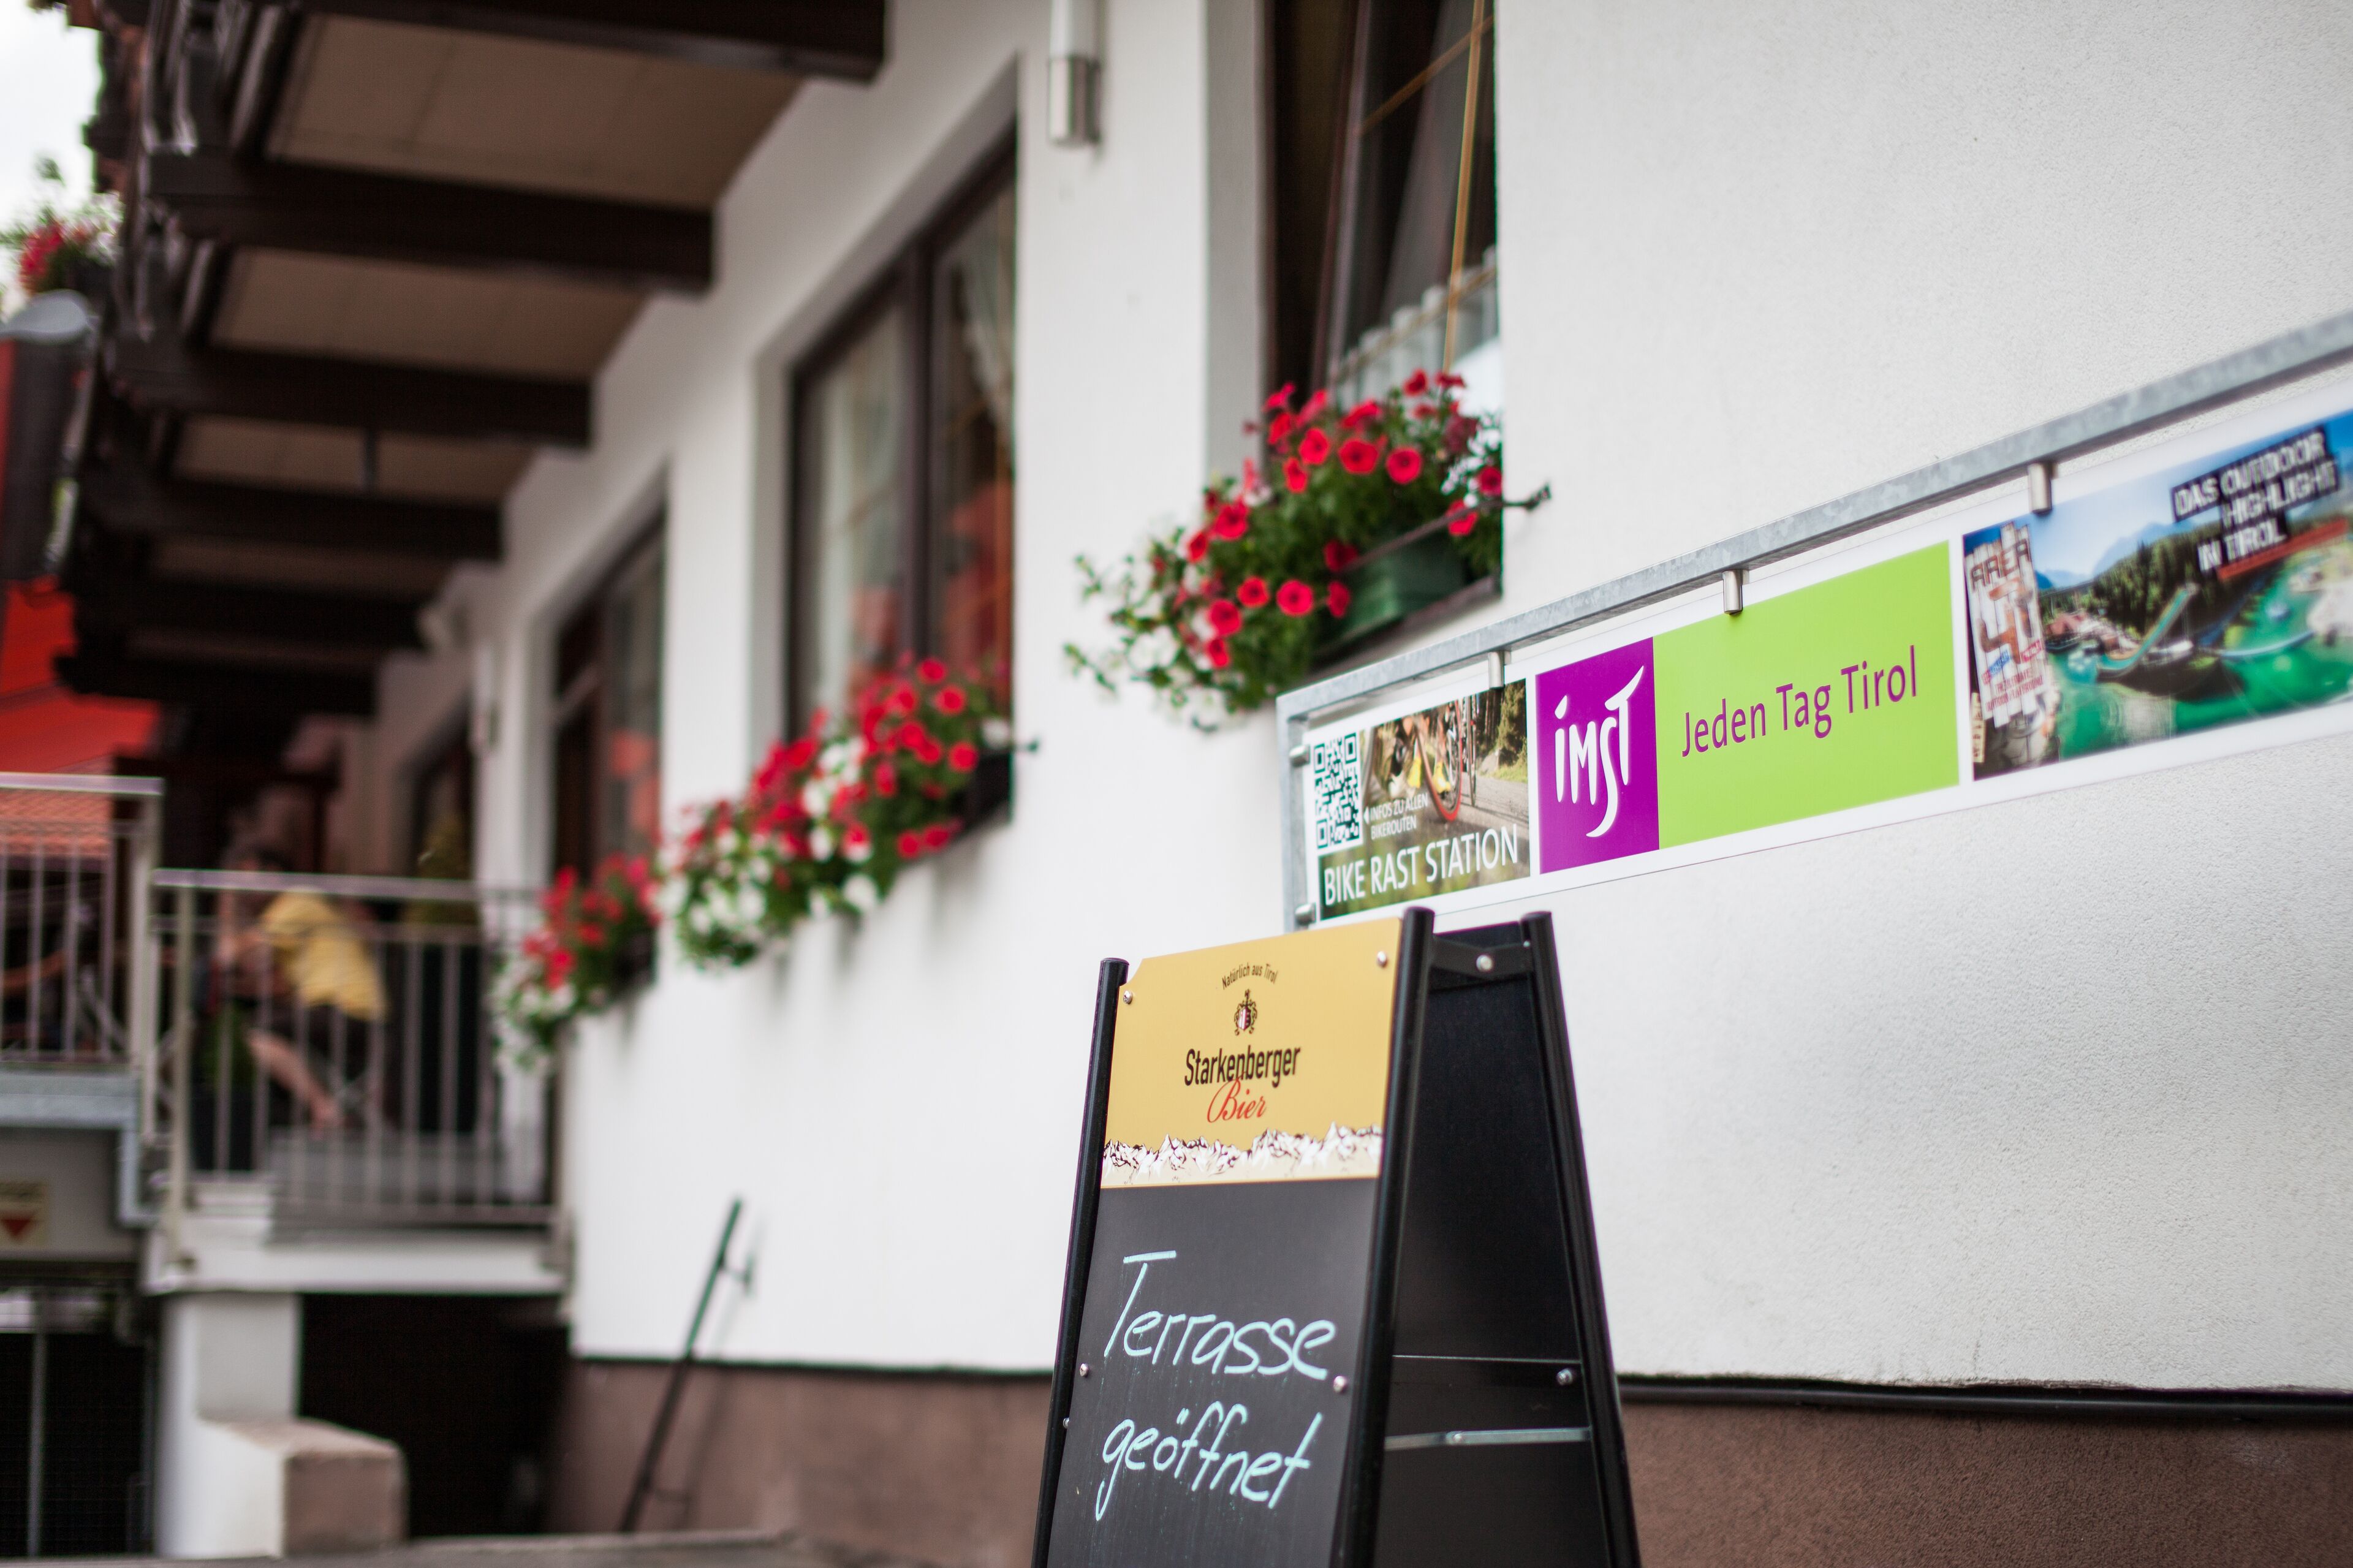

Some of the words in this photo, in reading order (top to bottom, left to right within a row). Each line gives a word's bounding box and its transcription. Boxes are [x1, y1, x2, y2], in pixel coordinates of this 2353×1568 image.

[2176, 477, 2219, 517] DAS
[2220, 432, 2325, 496] OUTDOOR
[2221, 460, 2337, 529] HIGHLIGHT
[1970, 539, 2032, 593] AREA
[2197, 539, 2223, 572] IN
[2224, 518, 2288, 562] TIROL
[1681, 698, 1767, 757] Jeden
[1775, 682, 1832, 739] Tag
[1840, 645, 1918, 714] Tirol
[1370, 802, 1393, 821] INFOS
[1393, 799, 1404, 816] ZU
[1405, 792, 1429, 811] ALLEN
[1371, 814, 1417, 840] BIKEROUTEN
[1324, 860, 1366, 906] BIKE
[1370, 844, 1420, 895] RAST
[1425, 823, 1518, 882] STATION
[1221, 961, 1250, 990] Natürlich
[1251, 964, 1263, 976] aus
[1264, 963, 1278, 985] Tirol
[1183, 1044, 1301, 1088] Starkenberger
[1206, 1075, 1268, 1123] Bier
[1104, 1250, 1336, 1381] Terrasse
[1096, 1400, 1323, 1521] geöffnet
